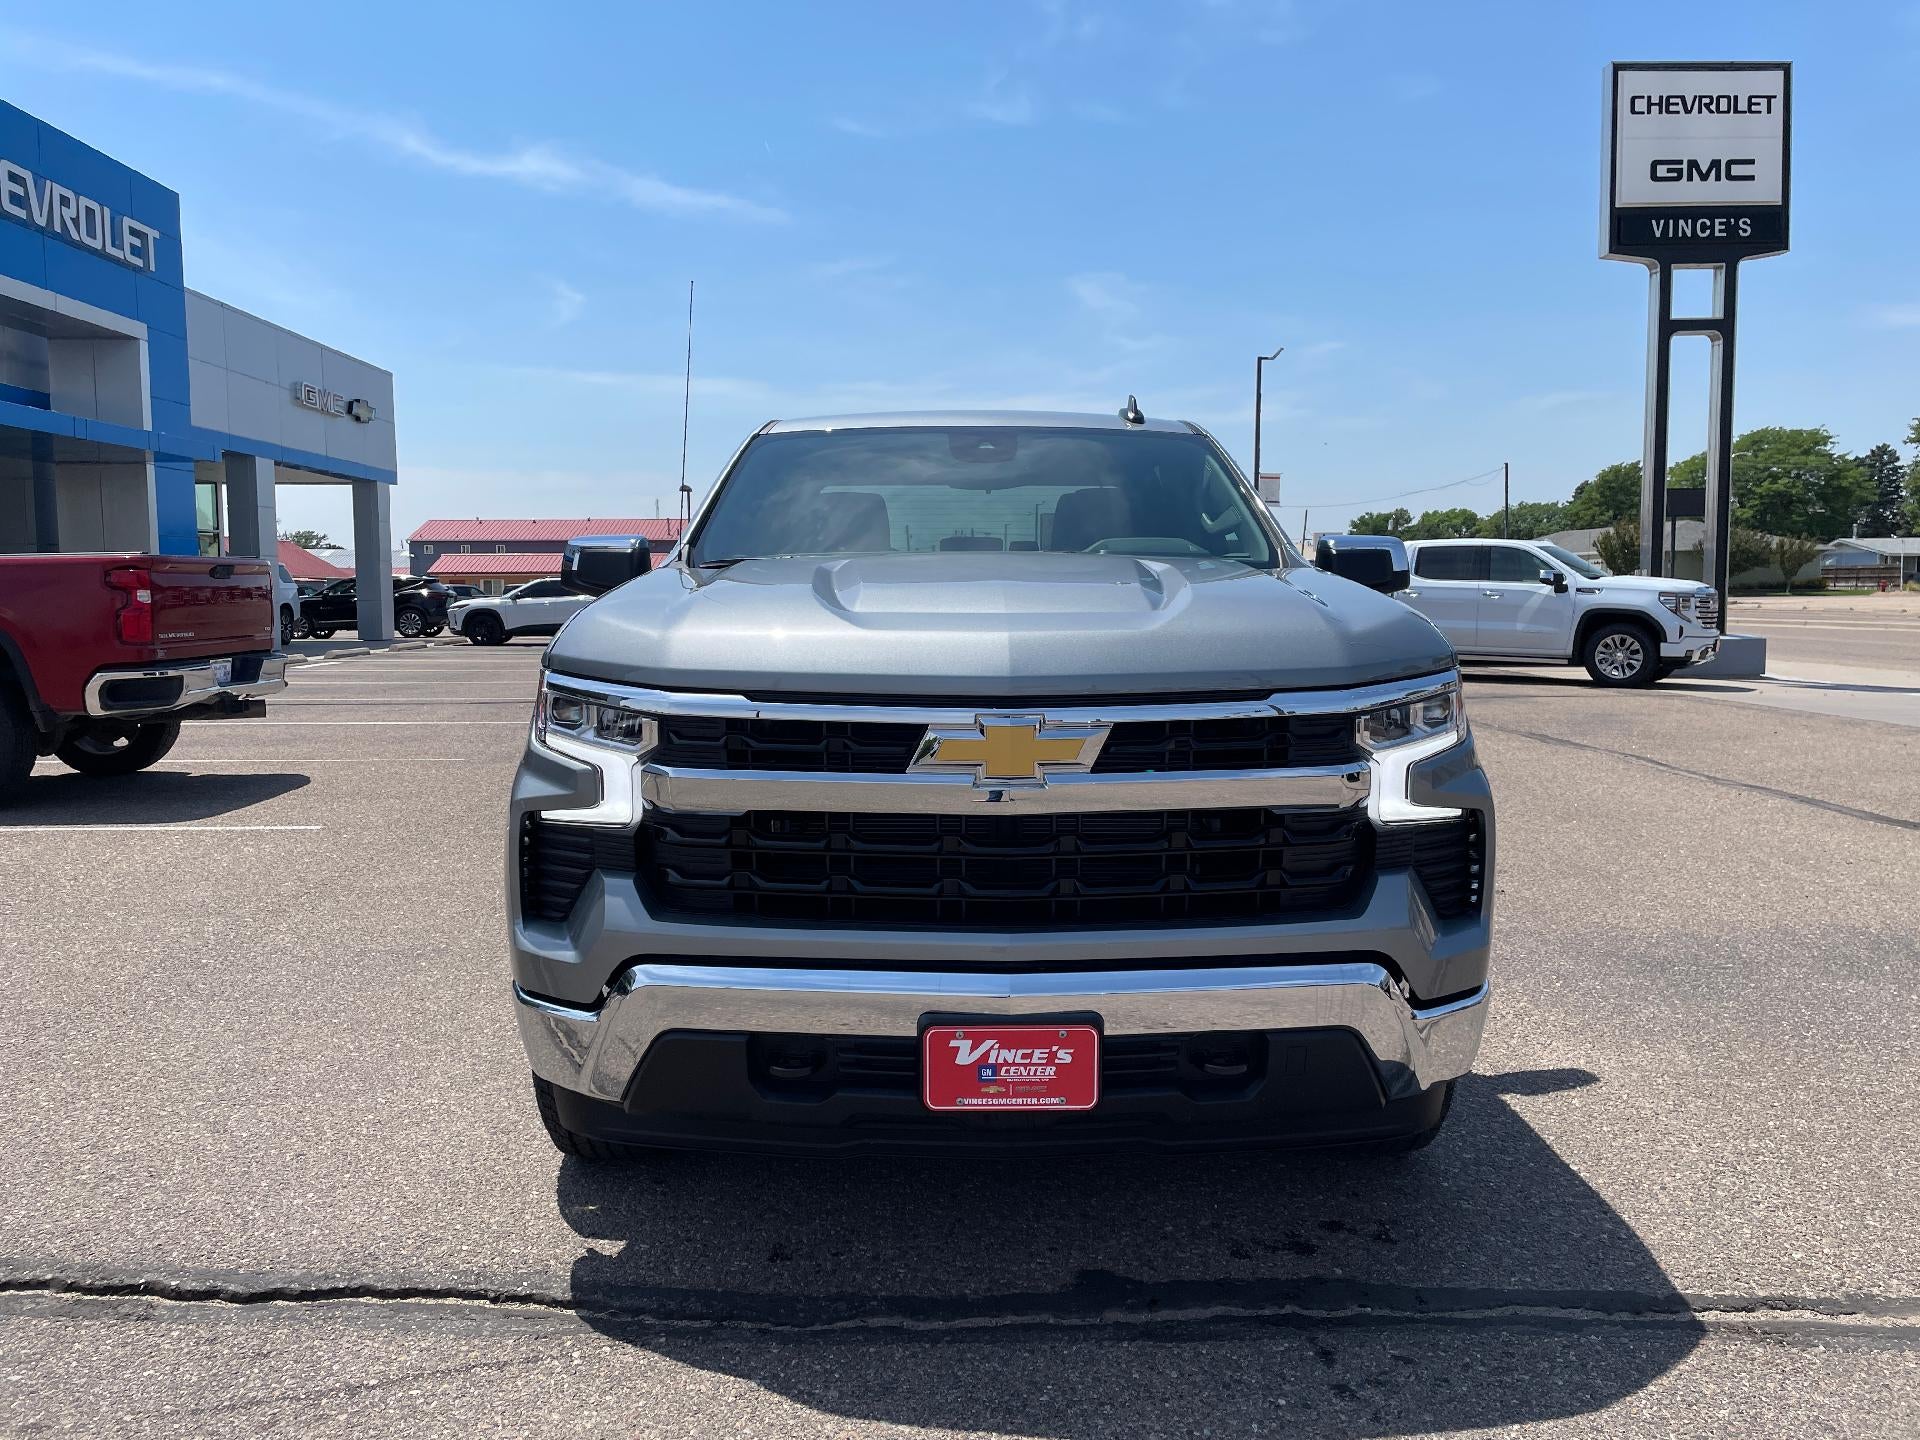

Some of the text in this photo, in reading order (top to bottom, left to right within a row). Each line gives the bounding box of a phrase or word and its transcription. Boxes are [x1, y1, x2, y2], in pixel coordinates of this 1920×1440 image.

[1630, 95, 1777, 115] CHEVROLET
[1650, 158, 1755, 182] GMC
[0, 159, 160, 272] EVROLET
[1651, 217, 1752, 238] VINCE'S
[300, 382, 346, 417] GMC
[949, 1039, 1075, 1065] VINCE'S
[1000, 1066, 1056, 1076] CENTER
[964, 1097, 1060, 1105] VINCESGMCENTER.COM
